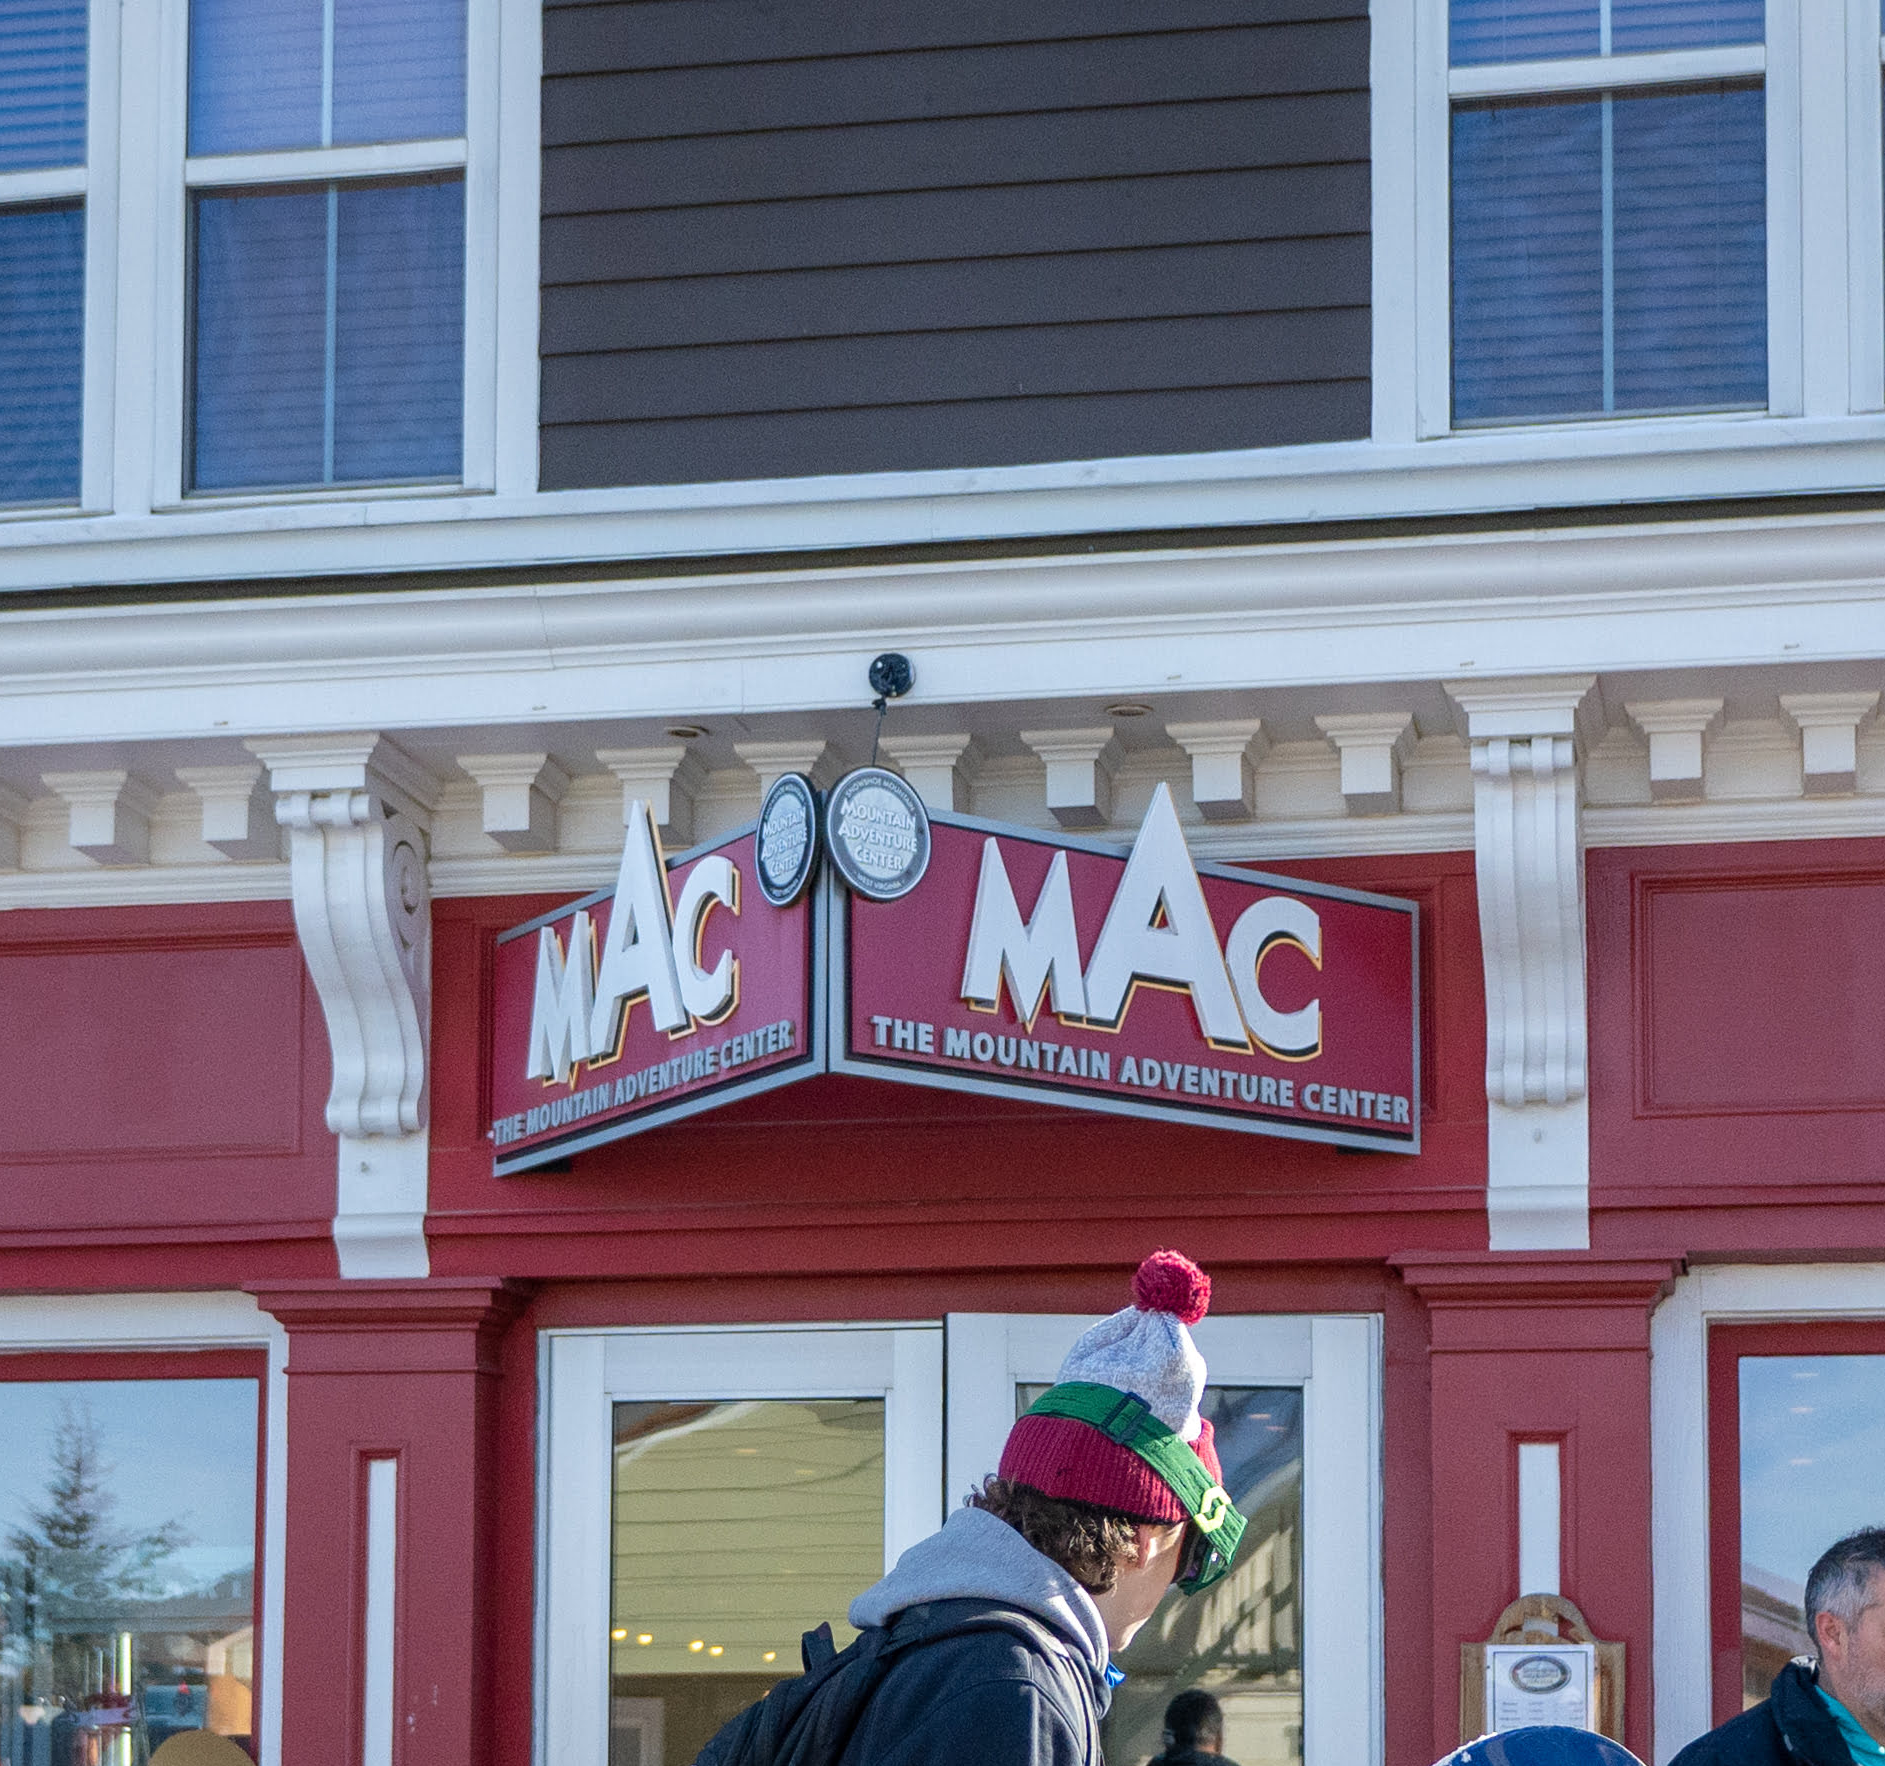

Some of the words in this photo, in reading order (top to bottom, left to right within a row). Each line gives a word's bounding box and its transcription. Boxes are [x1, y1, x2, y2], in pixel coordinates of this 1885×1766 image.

[762, 806, 807, 840] MOUNTAIN
[840, 798, 916, 830] MOUNTAIN
[761, 827, 808, 862] ADVENTURE
[837, 821, 918, 853] ADVENTURE
[770, 853, 800, 878] CENTER
[854, 845, 904, 871] CENTER
[961, 782, 1321, 1062] MAC
[526, 799, 742, 1090] MAC
[493, 1117, 526, 1146] THE
[526, 1082, 610, 1136] MOUNTAIN
[614, 1046, 719, 1104] ADVENTURE
[720, 1019, 795, 1069] CENTER
[869, 1014, 935, 1054] THE
[942, 1028, 1111, 1081] MOUNTAIN
[1118, 1055, 1295, 1108] ADVENTURE
[1300, 1083, 1410, 1125] CENTER
